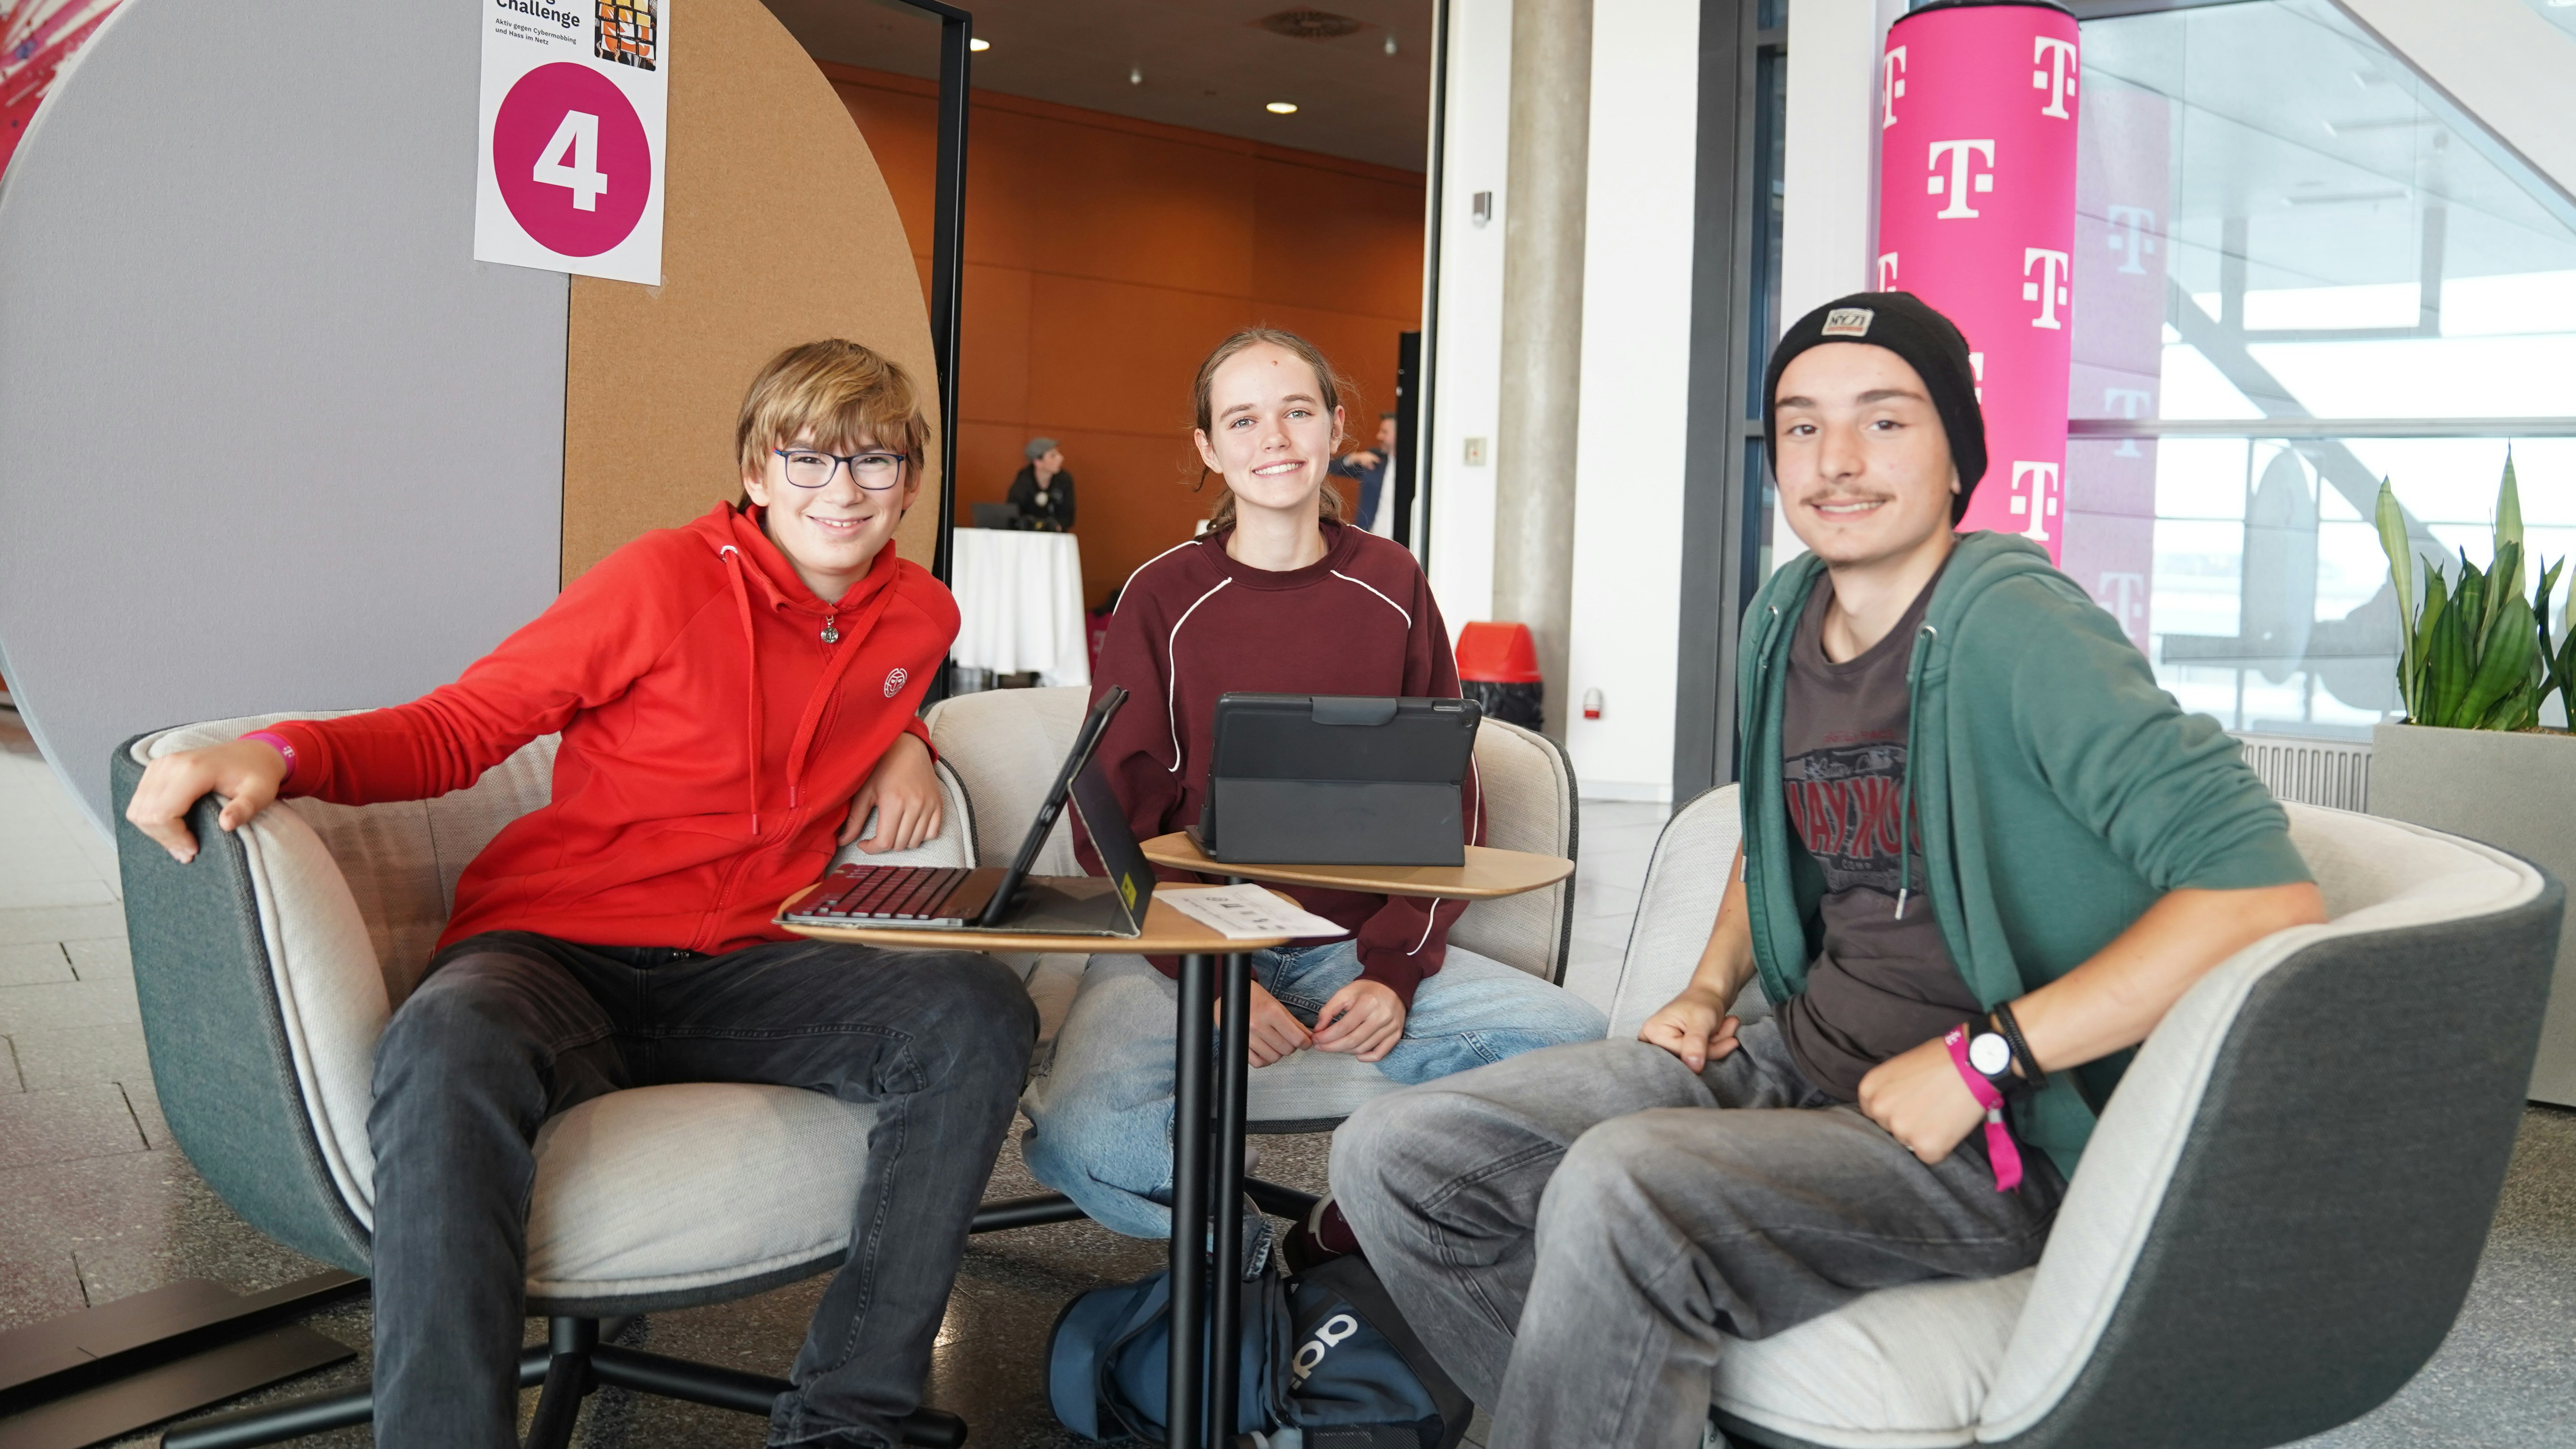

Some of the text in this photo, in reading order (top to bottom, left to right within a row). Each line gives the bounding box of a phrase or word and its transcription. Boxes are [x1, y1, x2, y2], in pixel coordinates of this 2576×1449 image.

[497, 0, 580, 28] Challenge
[495, 18, 577, 45] Aktiv gegen Cybermobbing
[509, 31, 524, 39] Hass
[535, 37, 549, 45] Netz
[533, 109, 608, 213] 4
[1927, 139, 1996, 220] T
